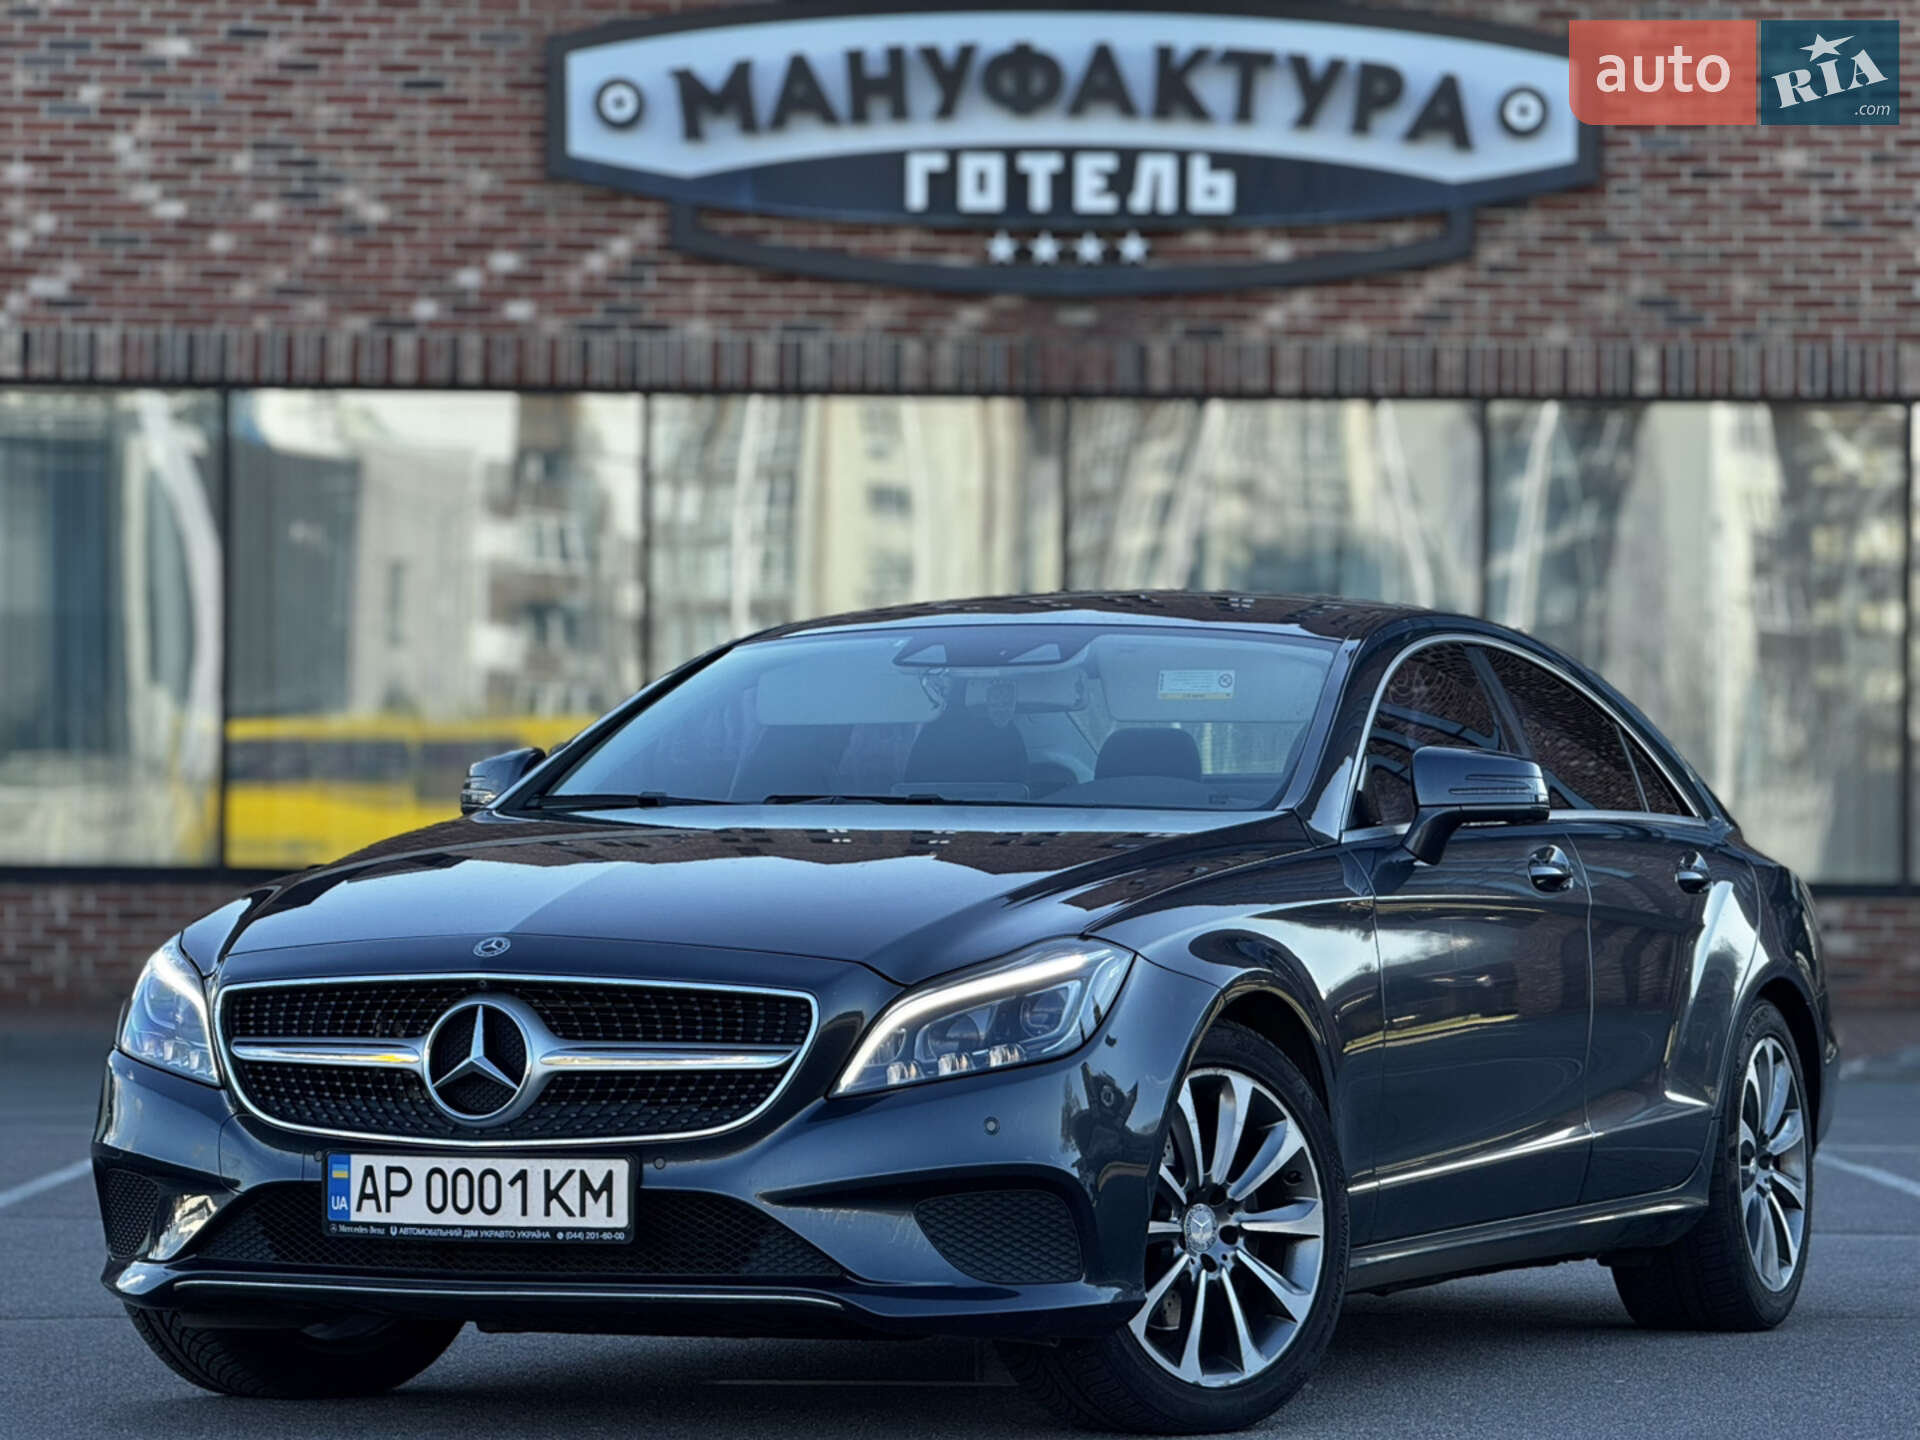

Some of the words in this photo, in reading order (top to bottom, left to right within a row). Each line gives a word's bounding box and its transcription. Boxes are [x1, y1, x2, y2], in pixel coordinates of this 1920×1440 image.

[669, 41, 1474, 152] МАНУФАКТУРА
[904, 150, 1237, 215] ГОТЕЛЬ
[331, 1196, 349, 1211] UA
[355, 1164, 413, 1214] AP
[425, 1166, 528, 1217] 0001
[543, 1168, 614, 1218] KM
